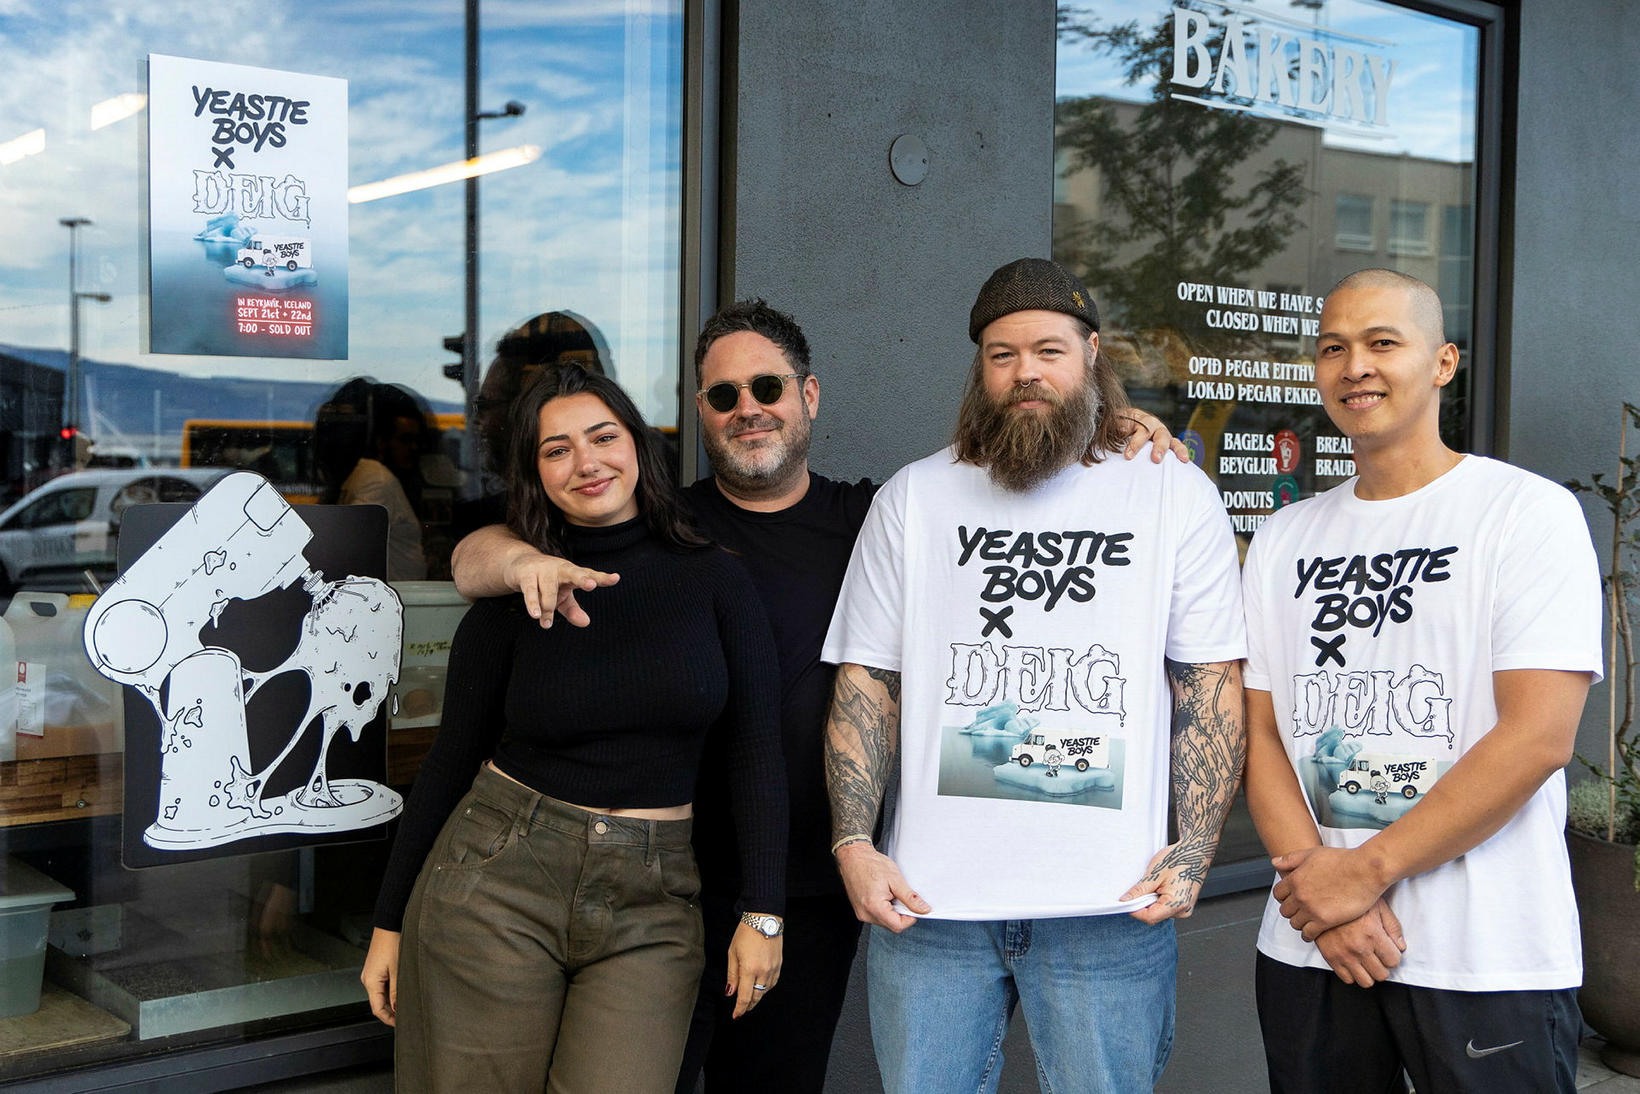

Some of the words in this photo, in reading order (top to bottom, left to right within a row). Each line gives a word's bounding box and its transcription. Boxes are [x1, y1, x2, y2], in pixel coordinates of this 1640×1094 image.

[1170, 7, 1400, 127] BAKERY
[192, 85, 310, 125] YEASTIE
[212, 118, 287, 152] BOYS
[192, 169, 311, 229] DEIG
[273, 242, 305, 253] YEASTIE
[280, 249, 300, 259] BOYS
[237, 298, 245, 306] IN
[284, 301, 312, 310] ICELAND
[1177, 282, 1214, 303] OPEN
[1216, 285, 1255, 307] WHEN
[1258, 290, 1278, 310] WE
[1280, 293, 1313, 313] HAVE
[238, 308, 258, 318] SEPT
[261, 309, 280, 319] 21st
[290, 310, 312, 320] 22nd
[1206, 309, 1259, 331] CLOSED
[1262, 314, 1299, 335] WHEN
[1301, 318, 1320, 336] WE
[238, 323, 258, 333] 7:00
[269, 324, 292, 334] SOLD
[294, 326, 312, 336] OUT
[1188, 356, 1222, 376] OPIÐ
[1225, 359, 1270, 379] ÞEGAR
[1272, 362, 1316, 382] EITTHV
[1187, 380, 1235, 400] LOKAÐ
[1238, 384, 1282, 404] ÞEGAR
[1284, 386, 1324, 406] EKKE
[1224, 432, 1275, 452] BAGELS
[1220, 456, 1278, 476] BEYGLUR
[1224, 491, 1274, 508] DONUTS
[957, 525, 1135, 569] YEASTIE
[1294, 546, 1459, 599] YEASTIE
[980, 565, 1096, 612] BOYS
[1311, 584, 1414, 638] BOYS
[945, 641, 1127, 728] DEIG
[1292, 664, 1455, 750] DEIG
[1060, 736, 1101, 749] YEASTIE
[1067, 746, 1094, 757] BOYS
[1384, 761, 1428, 776] YEASTIE
[1392, 771, 1420, 782] BOYS
